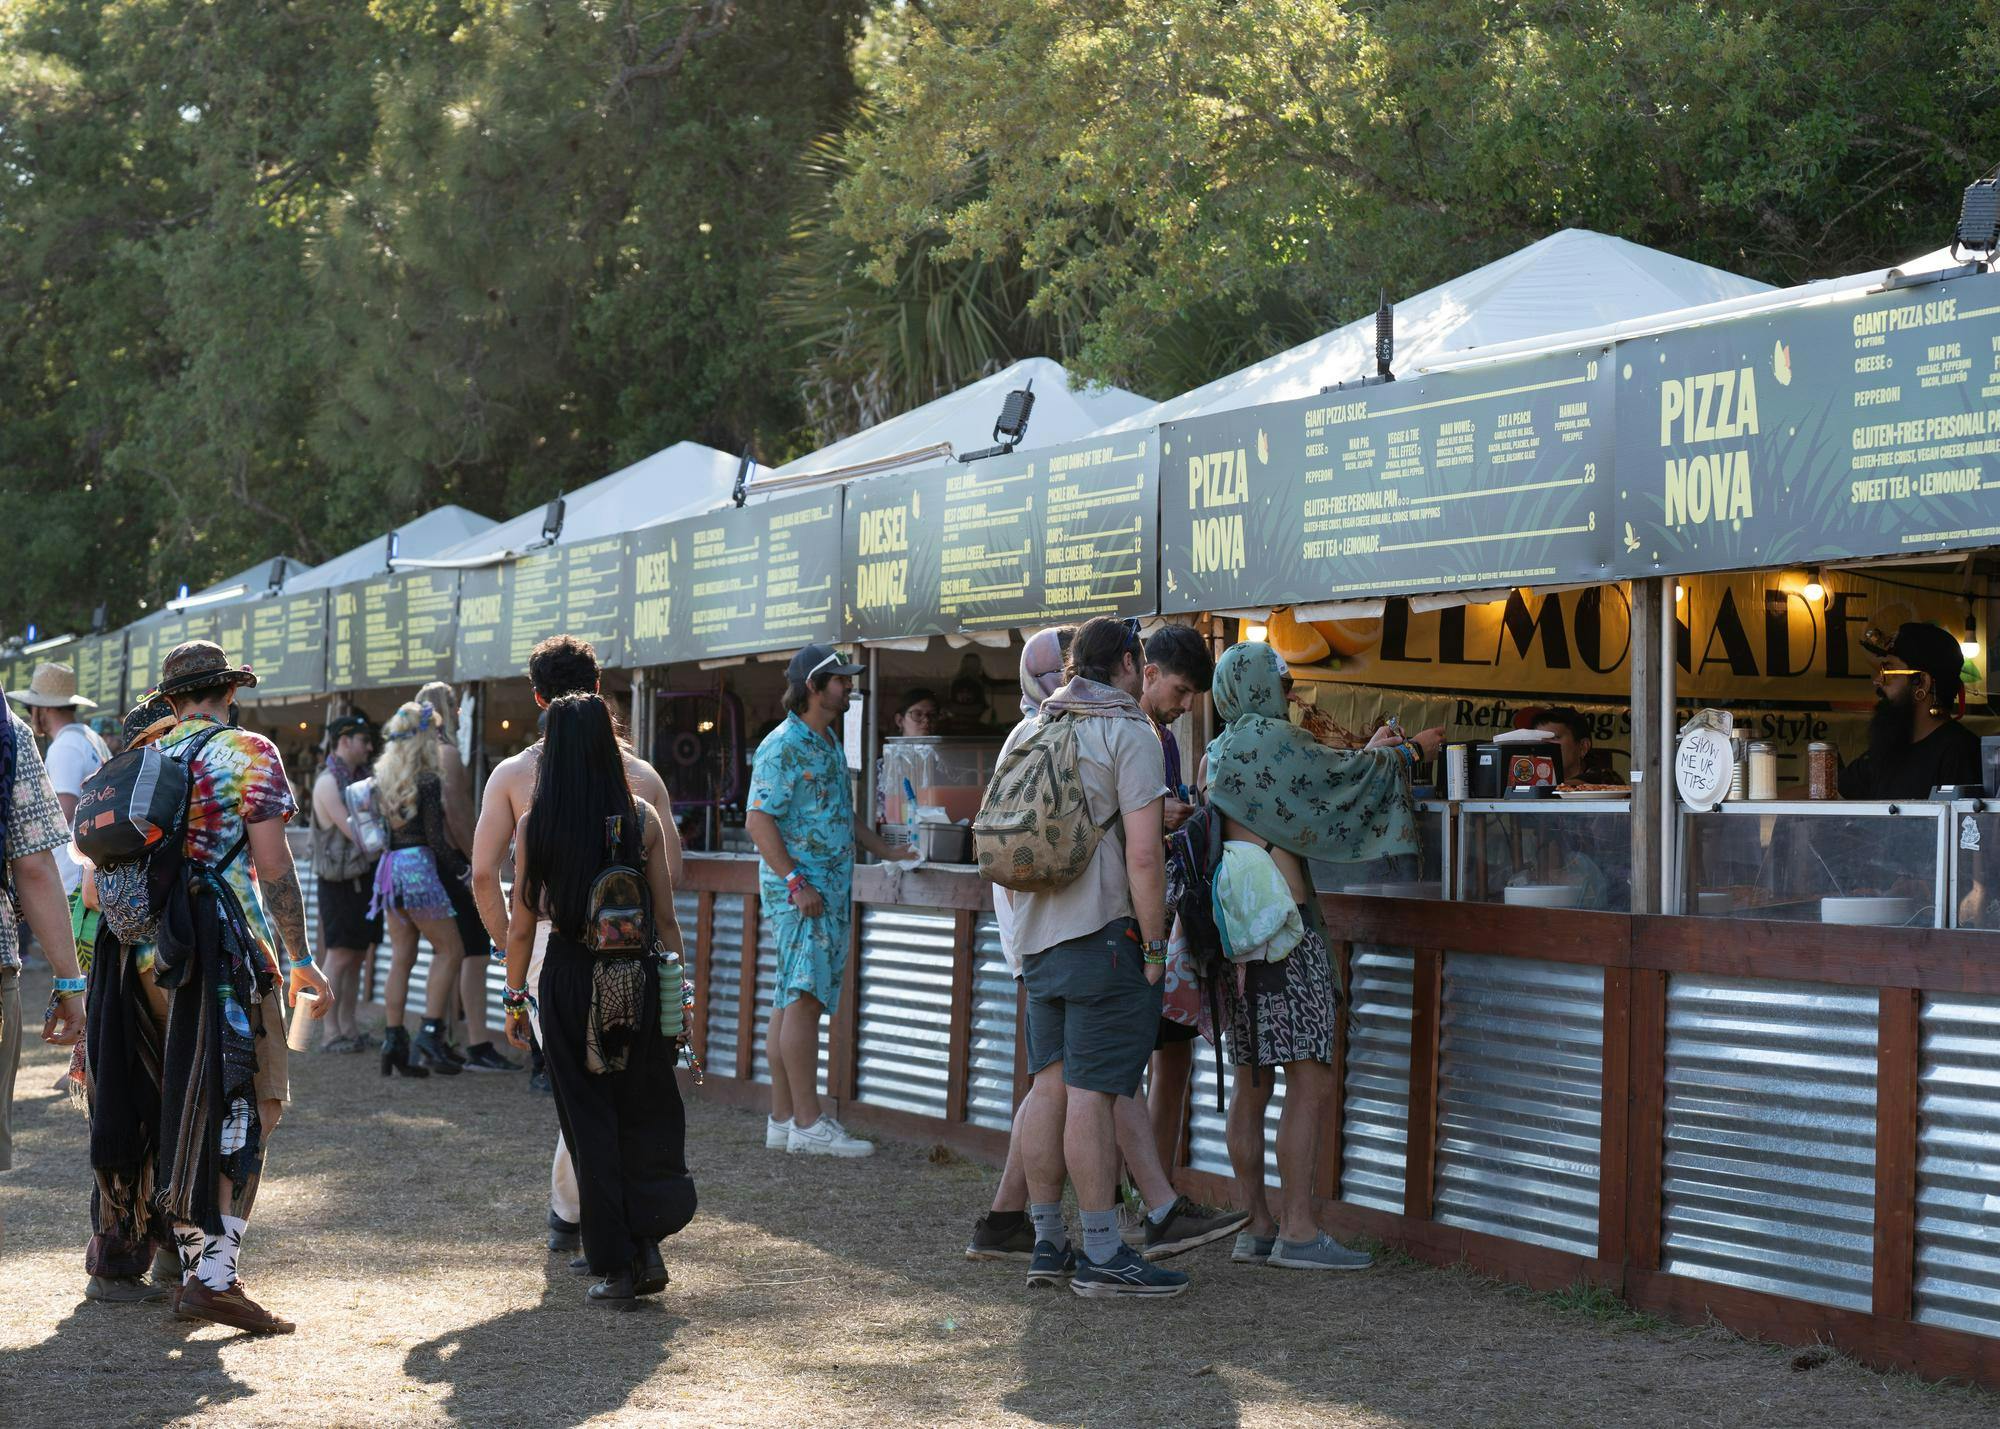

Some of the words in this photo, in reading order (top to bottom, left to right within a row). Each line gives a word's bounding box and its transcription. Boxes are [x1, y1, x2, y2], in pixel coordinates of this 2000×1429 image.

[1853, 310, 1888, 336] GIANT
[1889, 304, 1923, 331] PIZZA
[1925, 299, 1957, 325] SLICE
[1855, 354, 1886, 374] CHEESE
[1928, 345, 1945, 362] WAR
[1946, 342, 1961, 359] PIG
[1305, 408, 1325, 429] GIANT
[1326, 405, 1347, 425] PIZZA
[1347, 401, 1367, 422] SLICE
[1586, 361, 1598, 382] 10
[1661, 367, 1759, 447] PIZZA
[1855, 386, 1901, 407] PEPPERONI
[1498, 414, 1508, 429] EAT
[1508, 413, 1513, 426] A
[1513, 410, 1531, 425] PEACH
[1853, 419, 1925, 450] GLUTEN-FREE
[1926, 411, 1986, 440] PERSONAL
[1305, 443, 1324, 457] CHEESE
[1188, 448, 1249, 511] PIZZA
[1304, 495, 1346, 518] GLUTEN-FREE
[1347, 490, 1382, 513] PERSONAL
[1383, 488, 1398, 508] PAN
[1584, 463, 1596, 485] 23
[1305, 468, 1333, 484] PEPPERONI
[1665, 449, 1753, 526] NOVA
[1851, 478, 1887, 503] SWEET
[1889, 475, 1910, 499] TEA
[1919, 467, 1982, 497] LEMONADE
[859, 505, 909, 557] DIESEL
[1134, 537, 1142, 553] 12
[1191, 514, 1246, 575] NOVA
[1303, 539, 1325, 560] SWEET
[1325, 538, 1337, 557] TEA
[1343, 534, 1380, 556] LEMONADE
[1588, 511, 1596, 533] 8
[636, 551, 671, 594] DIESEL
[1136, 558, 1142, 574] 8
[857, 559, 908, 610] DAWGZ
[1761, 711, 1829, 747] Style
[1681, 752, 1697, 769] ME
[1700, 758, 1714, 776] UR
[1686, 736, 1720, 759] SHOW
[1683, 770, 1710, 790] TIPS
